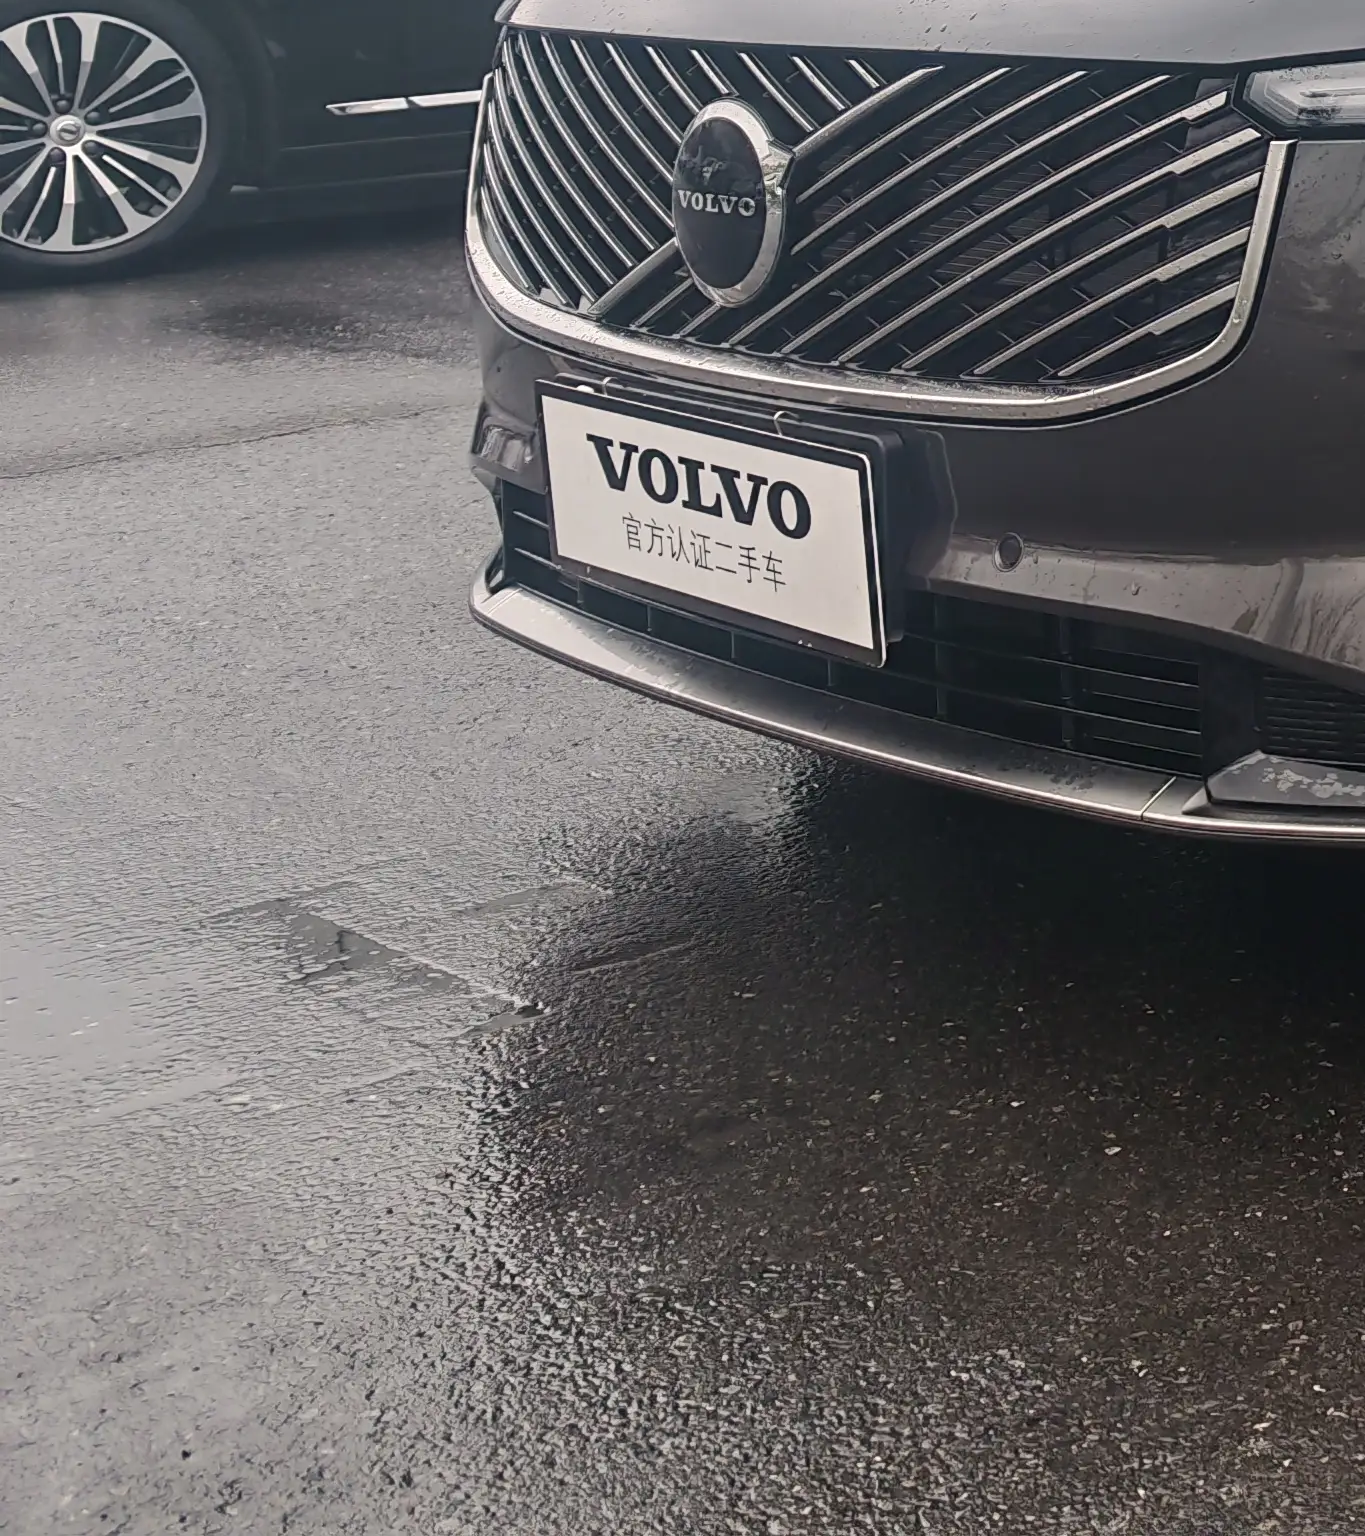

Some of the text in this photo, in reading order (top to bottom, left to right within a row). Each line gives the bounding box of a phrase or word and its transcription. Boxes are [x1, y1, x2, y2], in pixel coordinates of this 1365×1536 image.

[677, 189, 756, 217] VOLVO
[586, 432, 812, 540] VOLVO
[622, 512, 786, 592] 官方认证二手车
